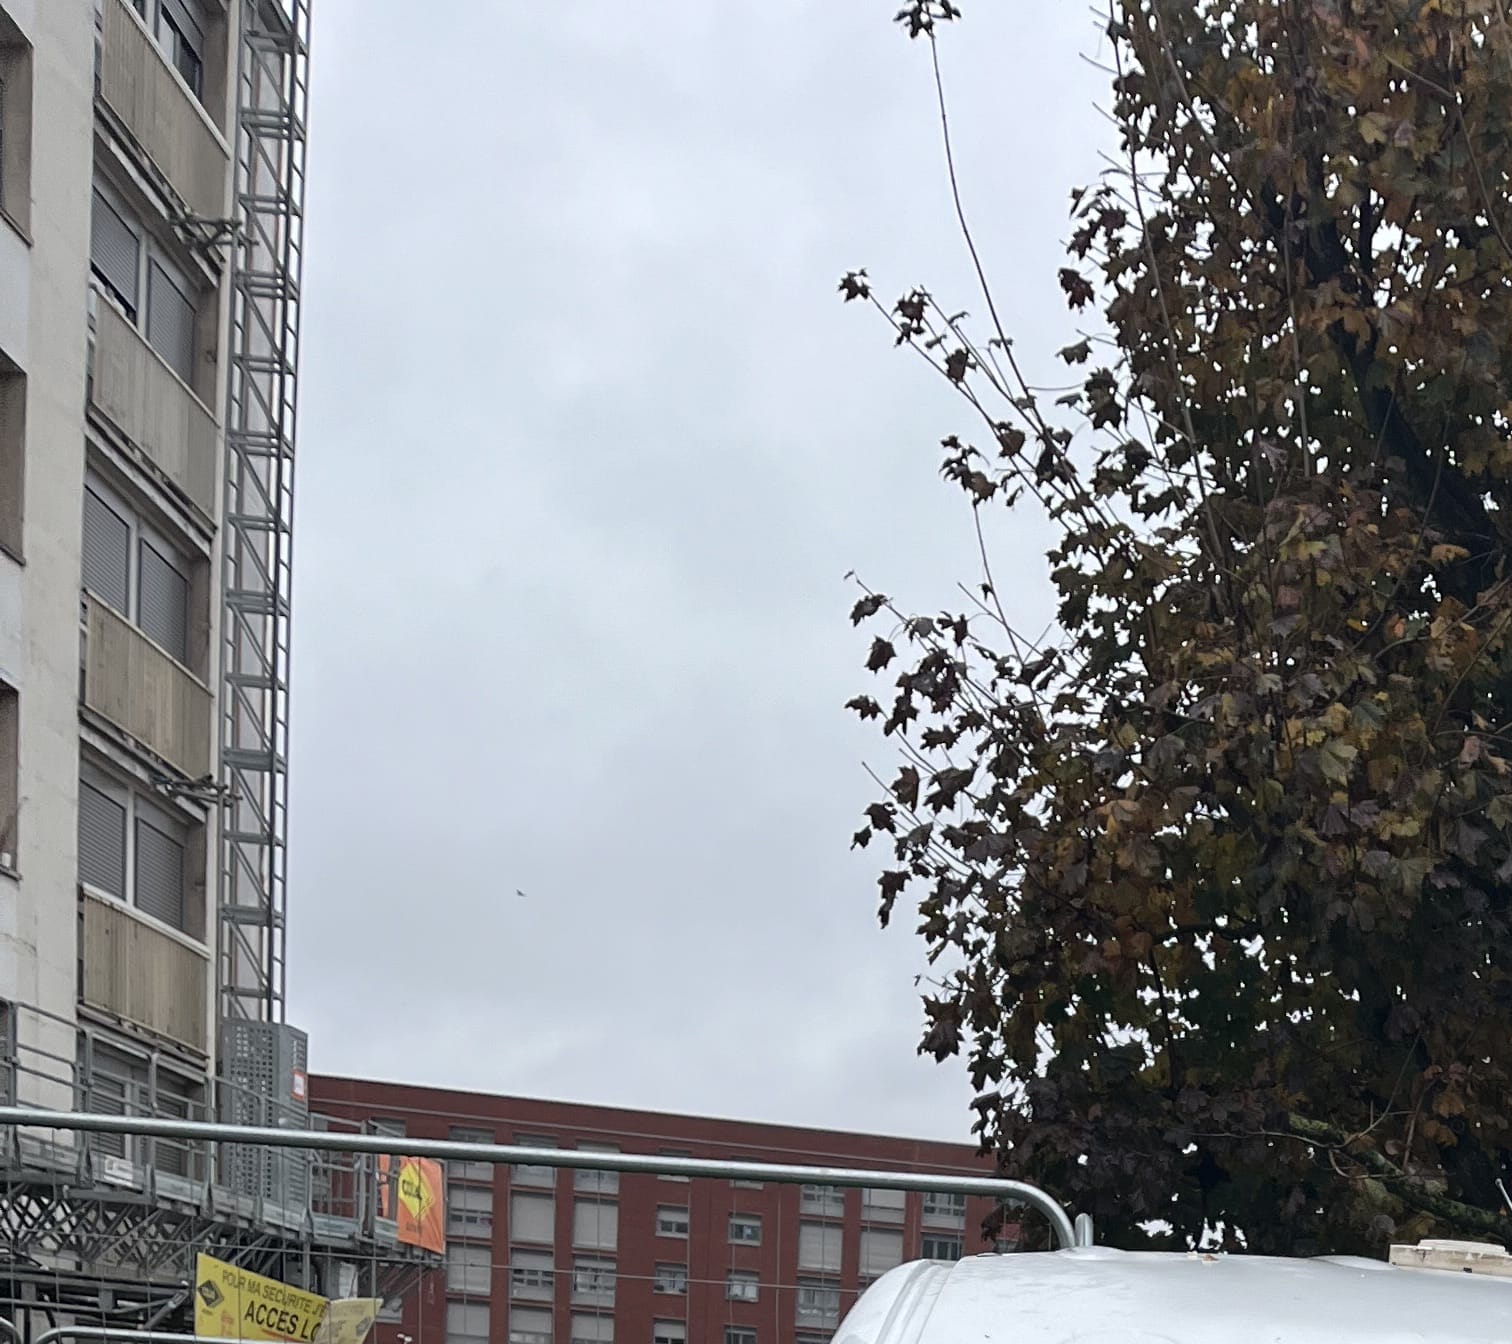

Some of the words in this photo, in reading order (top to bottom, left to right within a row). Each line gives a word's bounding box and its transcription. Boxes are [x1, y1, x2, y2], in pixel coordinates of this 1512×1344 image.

[221, 1269, 247, 1291] POUR
[247, 1278, 261, 1298] MA
[244, 1300, 300, 1335] ACCES
